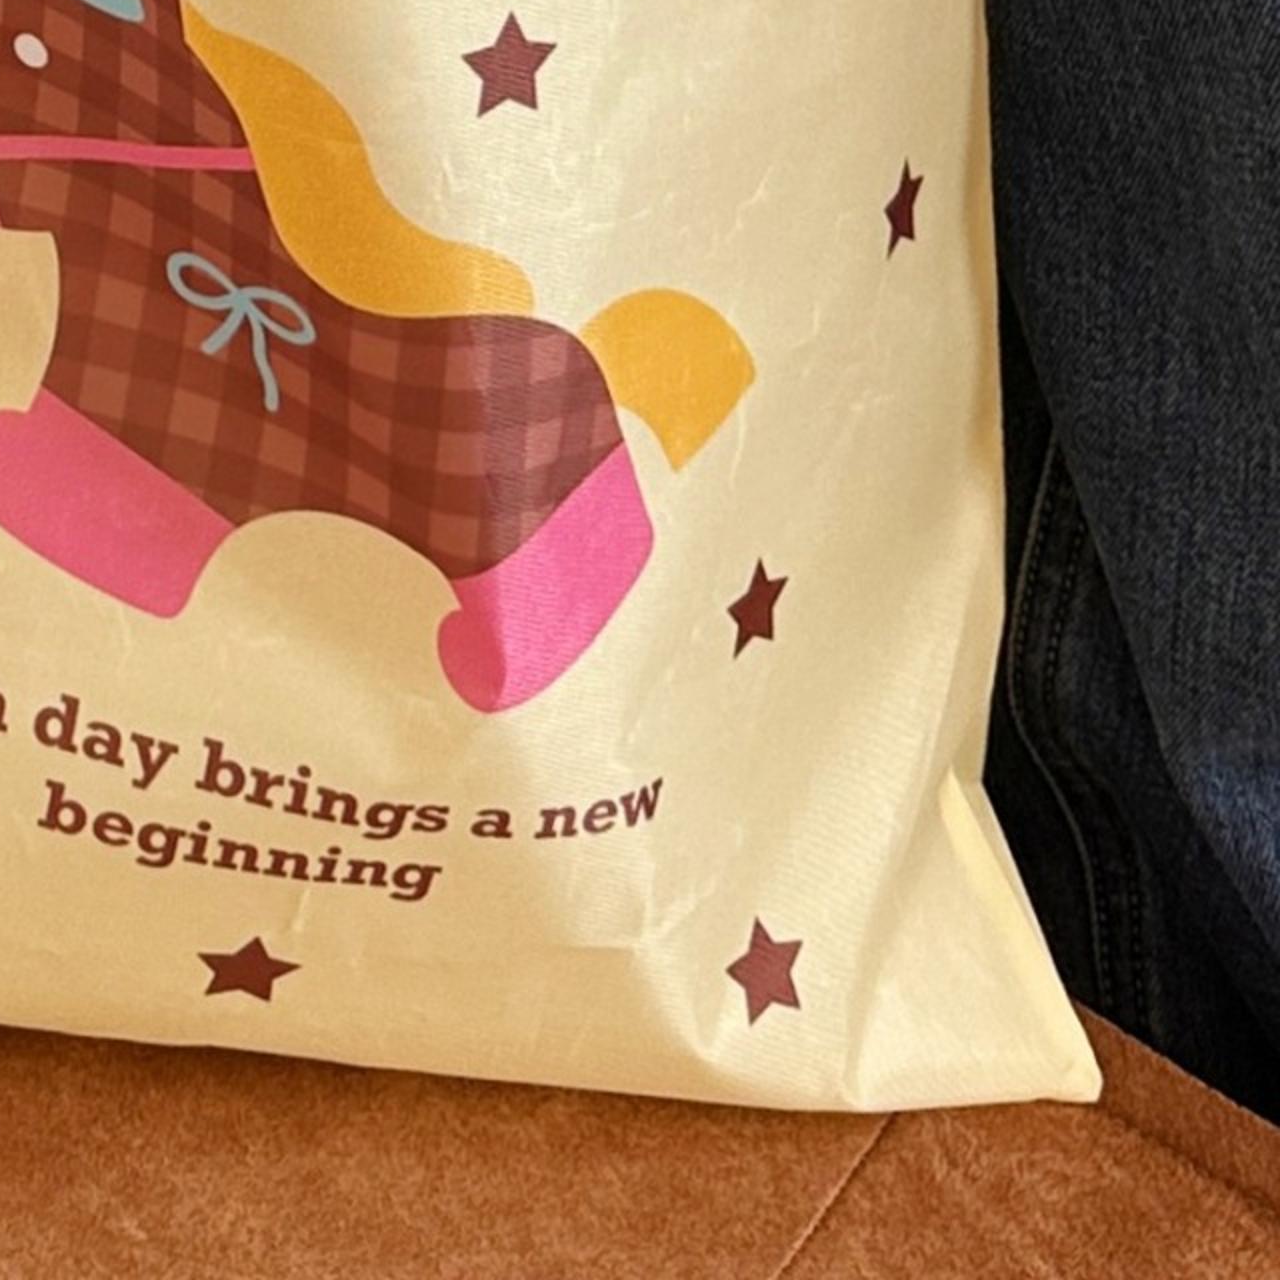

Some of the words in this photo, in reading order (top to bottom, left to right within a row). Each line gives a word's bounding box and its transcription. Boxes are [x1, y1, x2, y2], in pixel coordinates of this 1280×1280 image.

[33, 693, 181, 791] day
[194, 737, 451, 842] brings
[469, 808, 515, 840] a
[533, 777, 666, 841] new
[36, 778, 444, 903] beginning
